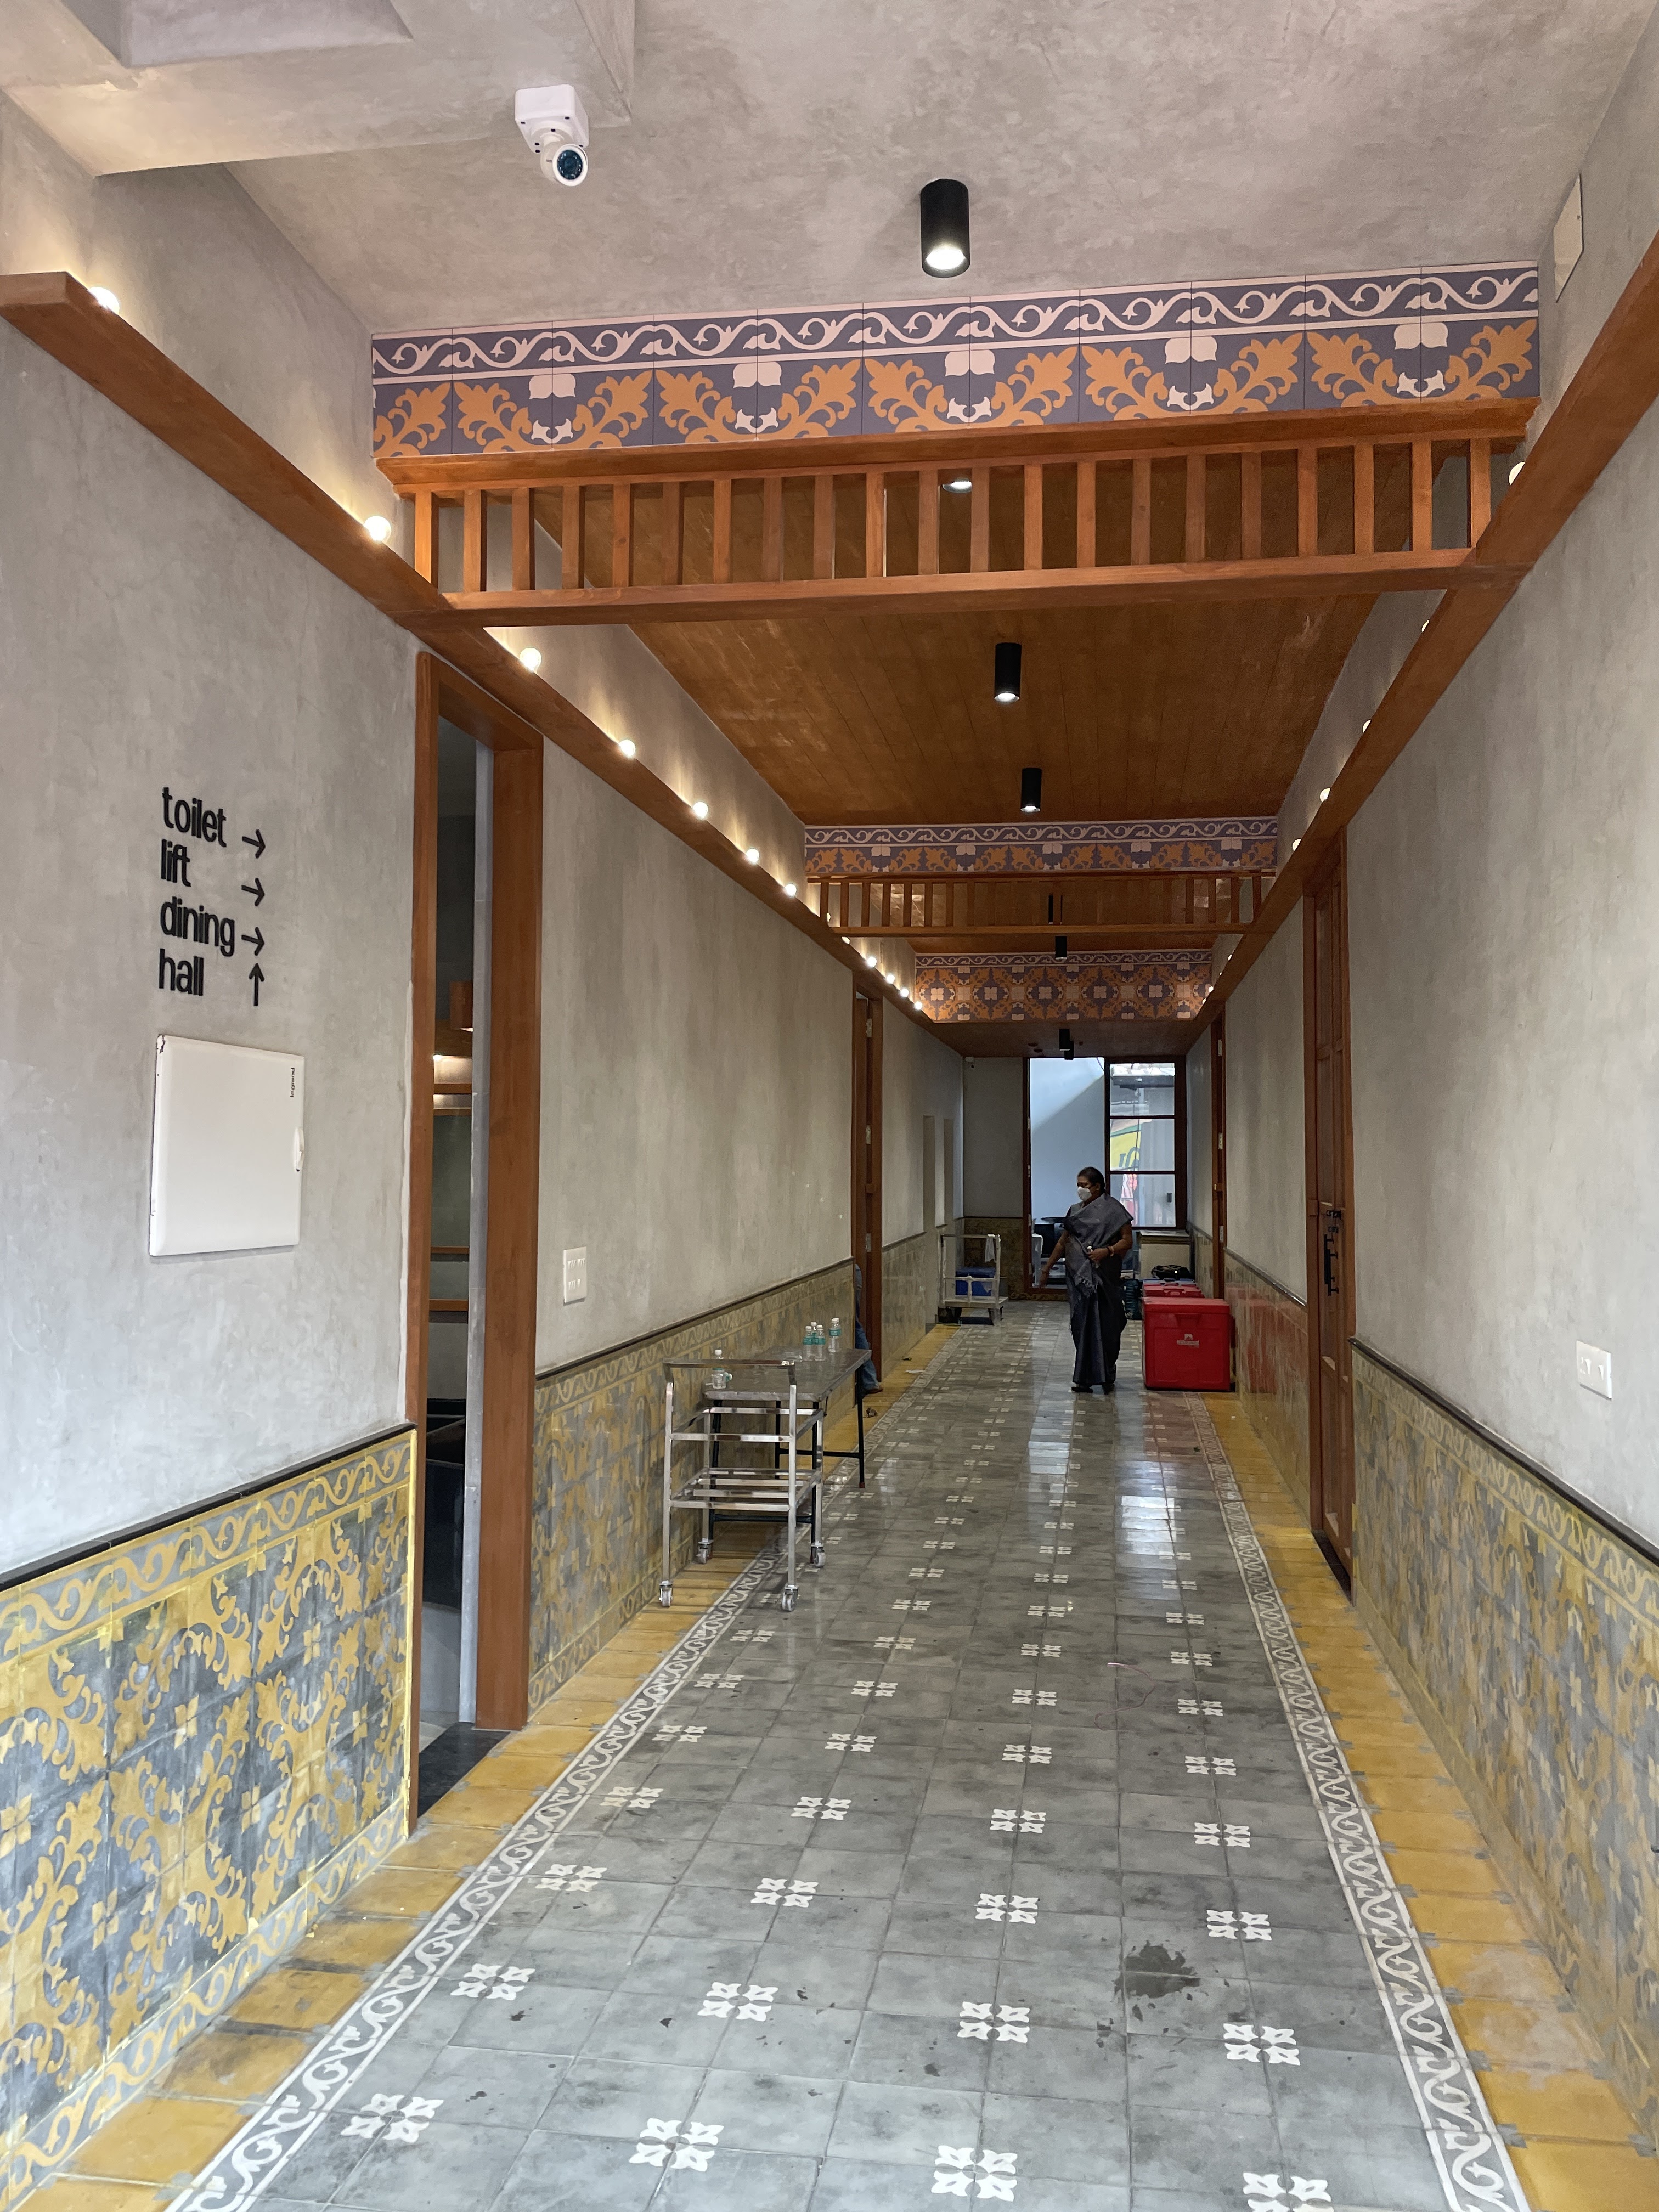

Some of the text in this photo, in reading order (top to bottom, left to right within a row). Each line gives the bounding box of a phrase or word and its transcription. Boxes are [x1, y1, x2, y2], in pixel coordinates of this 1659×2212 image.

[162, 787, 227, 848] toilet
[160, 838, 192, 887] lift
[160, 896, 235, 957] dining
[159, 948, 205, 996] hall
